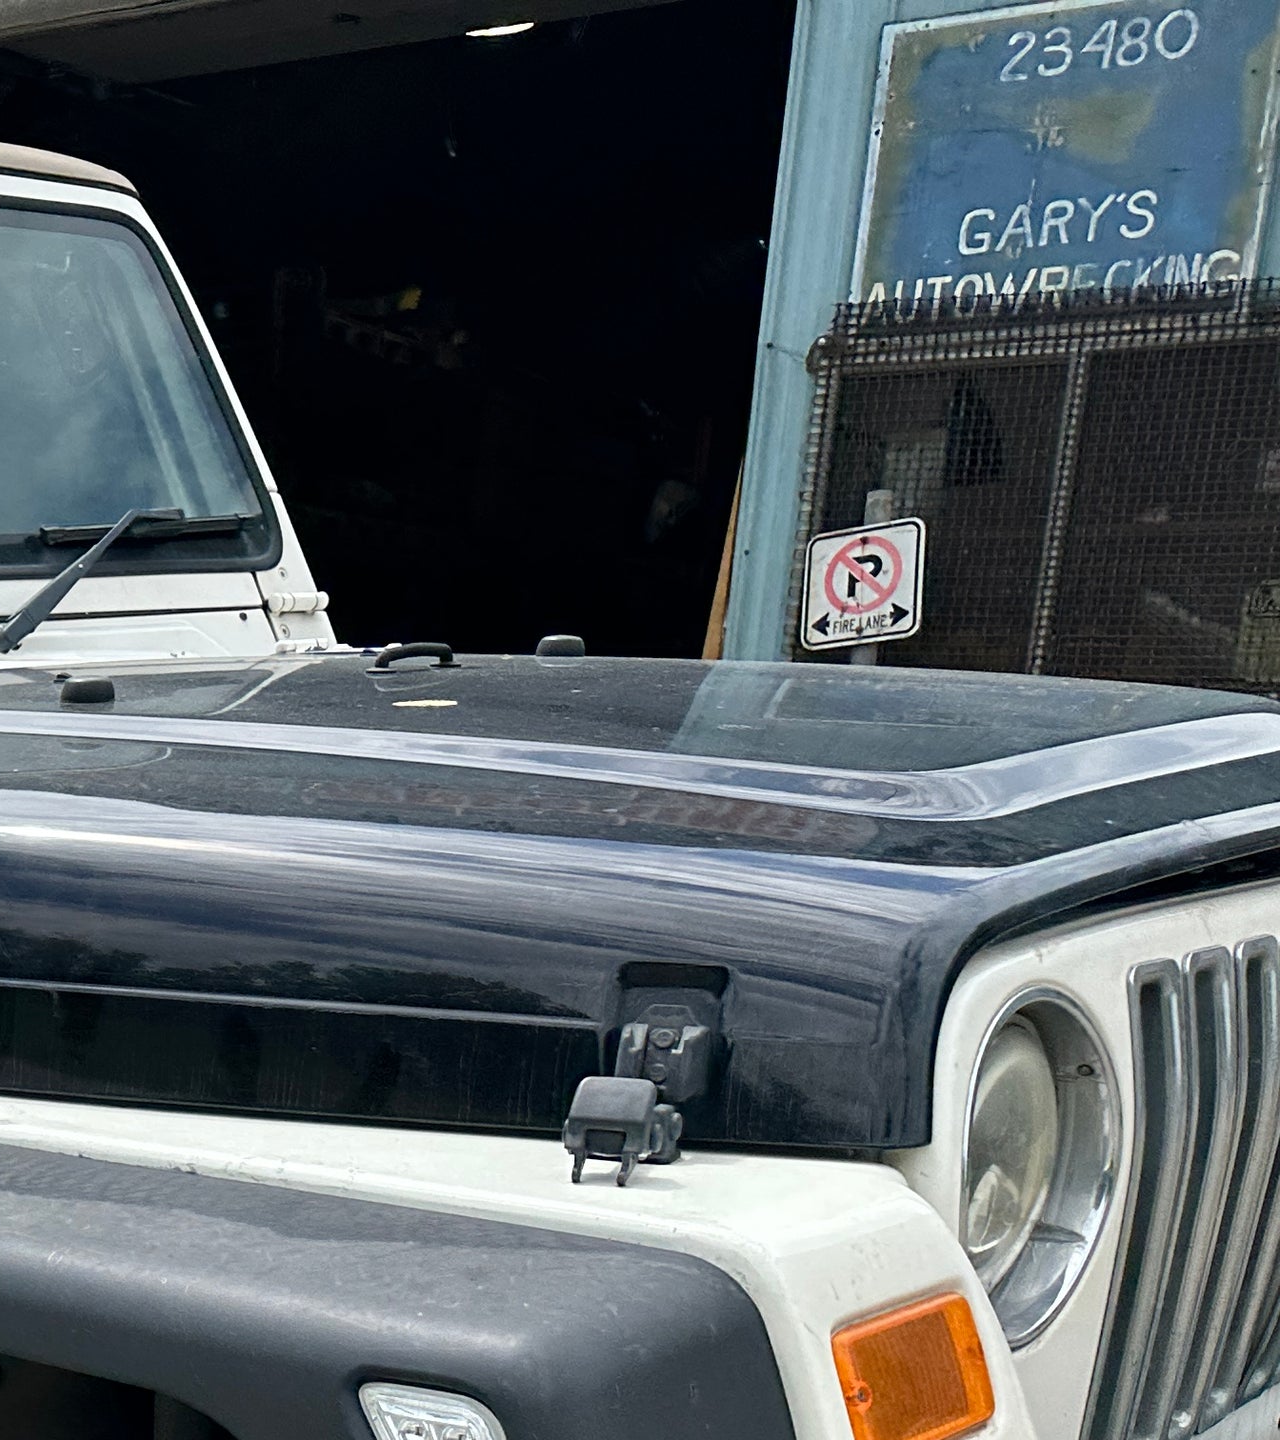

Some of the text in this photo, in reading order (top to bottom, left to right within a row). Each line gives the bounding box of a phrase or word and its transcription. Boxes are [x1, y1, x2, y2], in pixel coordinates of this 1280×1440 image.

[999, 8, 1200, 83] 23480
[957, 189, 1158, 257] GARY'S
[861, 249, 1242, 325] AUTOWRECKING
[832, 618, 856, 635] FIRE
